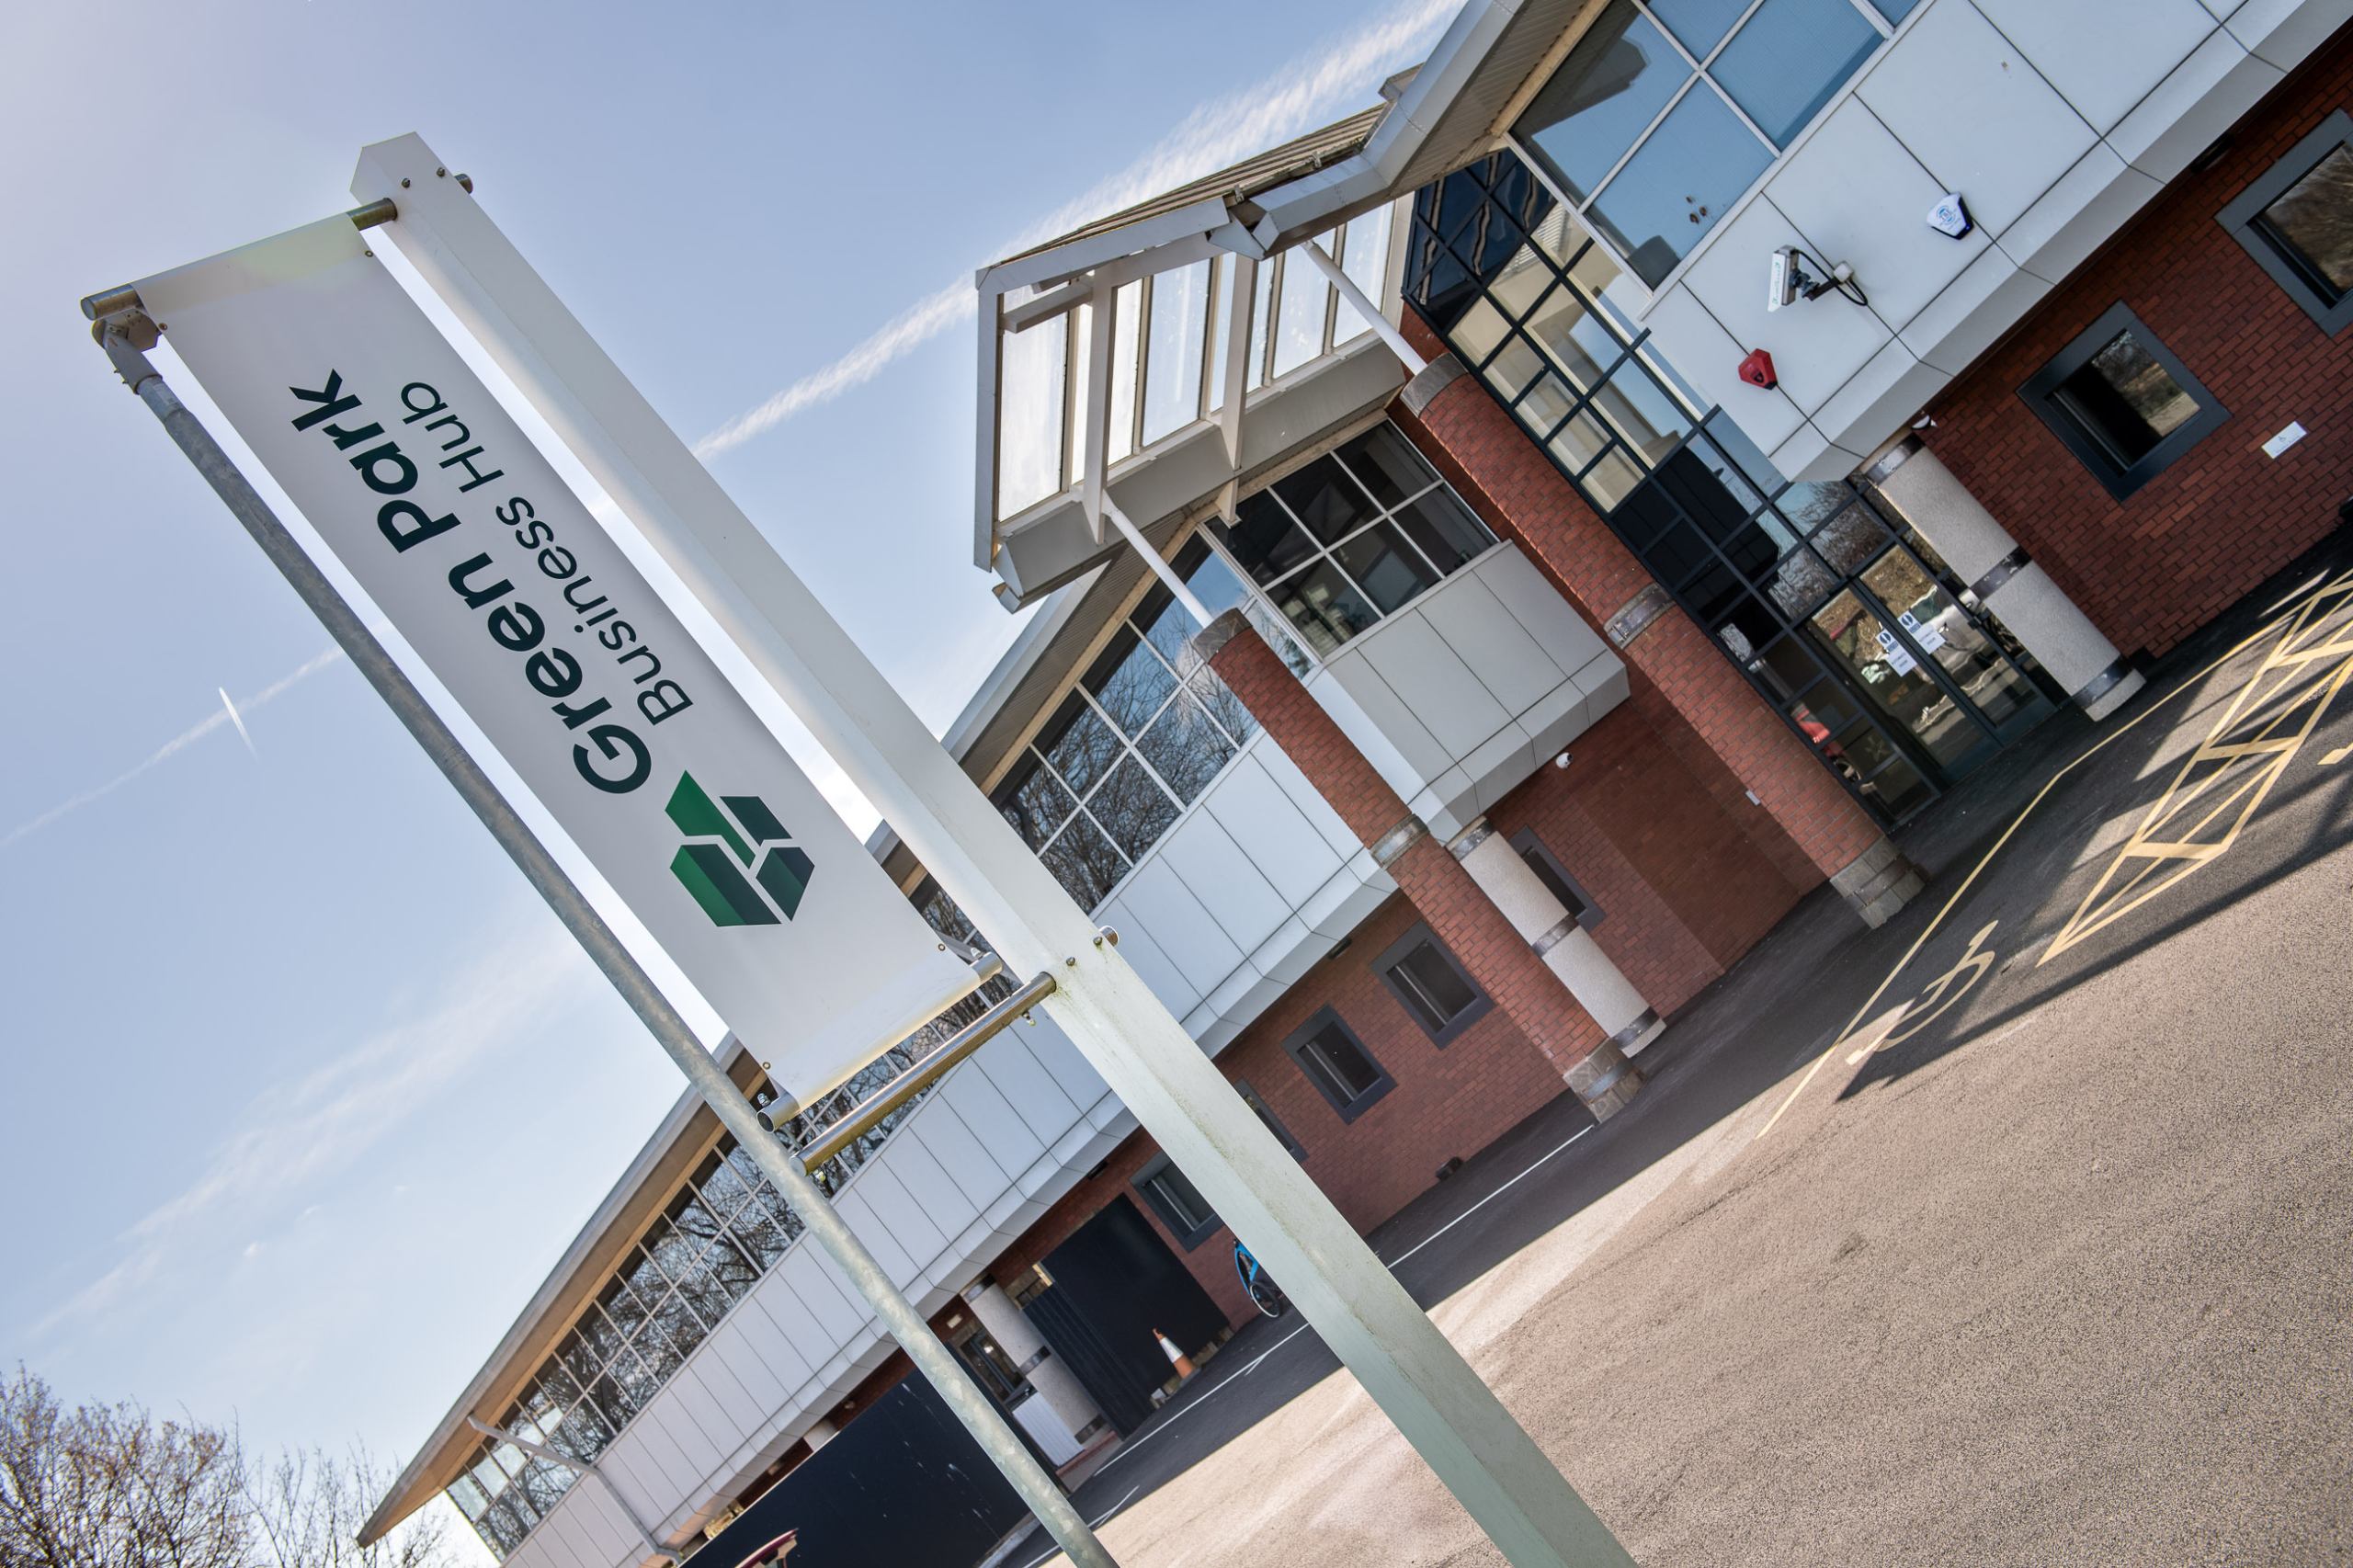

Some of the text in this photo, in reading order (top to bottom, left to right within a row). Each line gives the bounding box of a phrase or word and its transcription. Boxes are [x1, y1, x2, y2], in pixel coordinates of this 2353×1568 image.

[289, 368, 652, 794] Green Park
[401, 381, 694, 726] Business Hub
